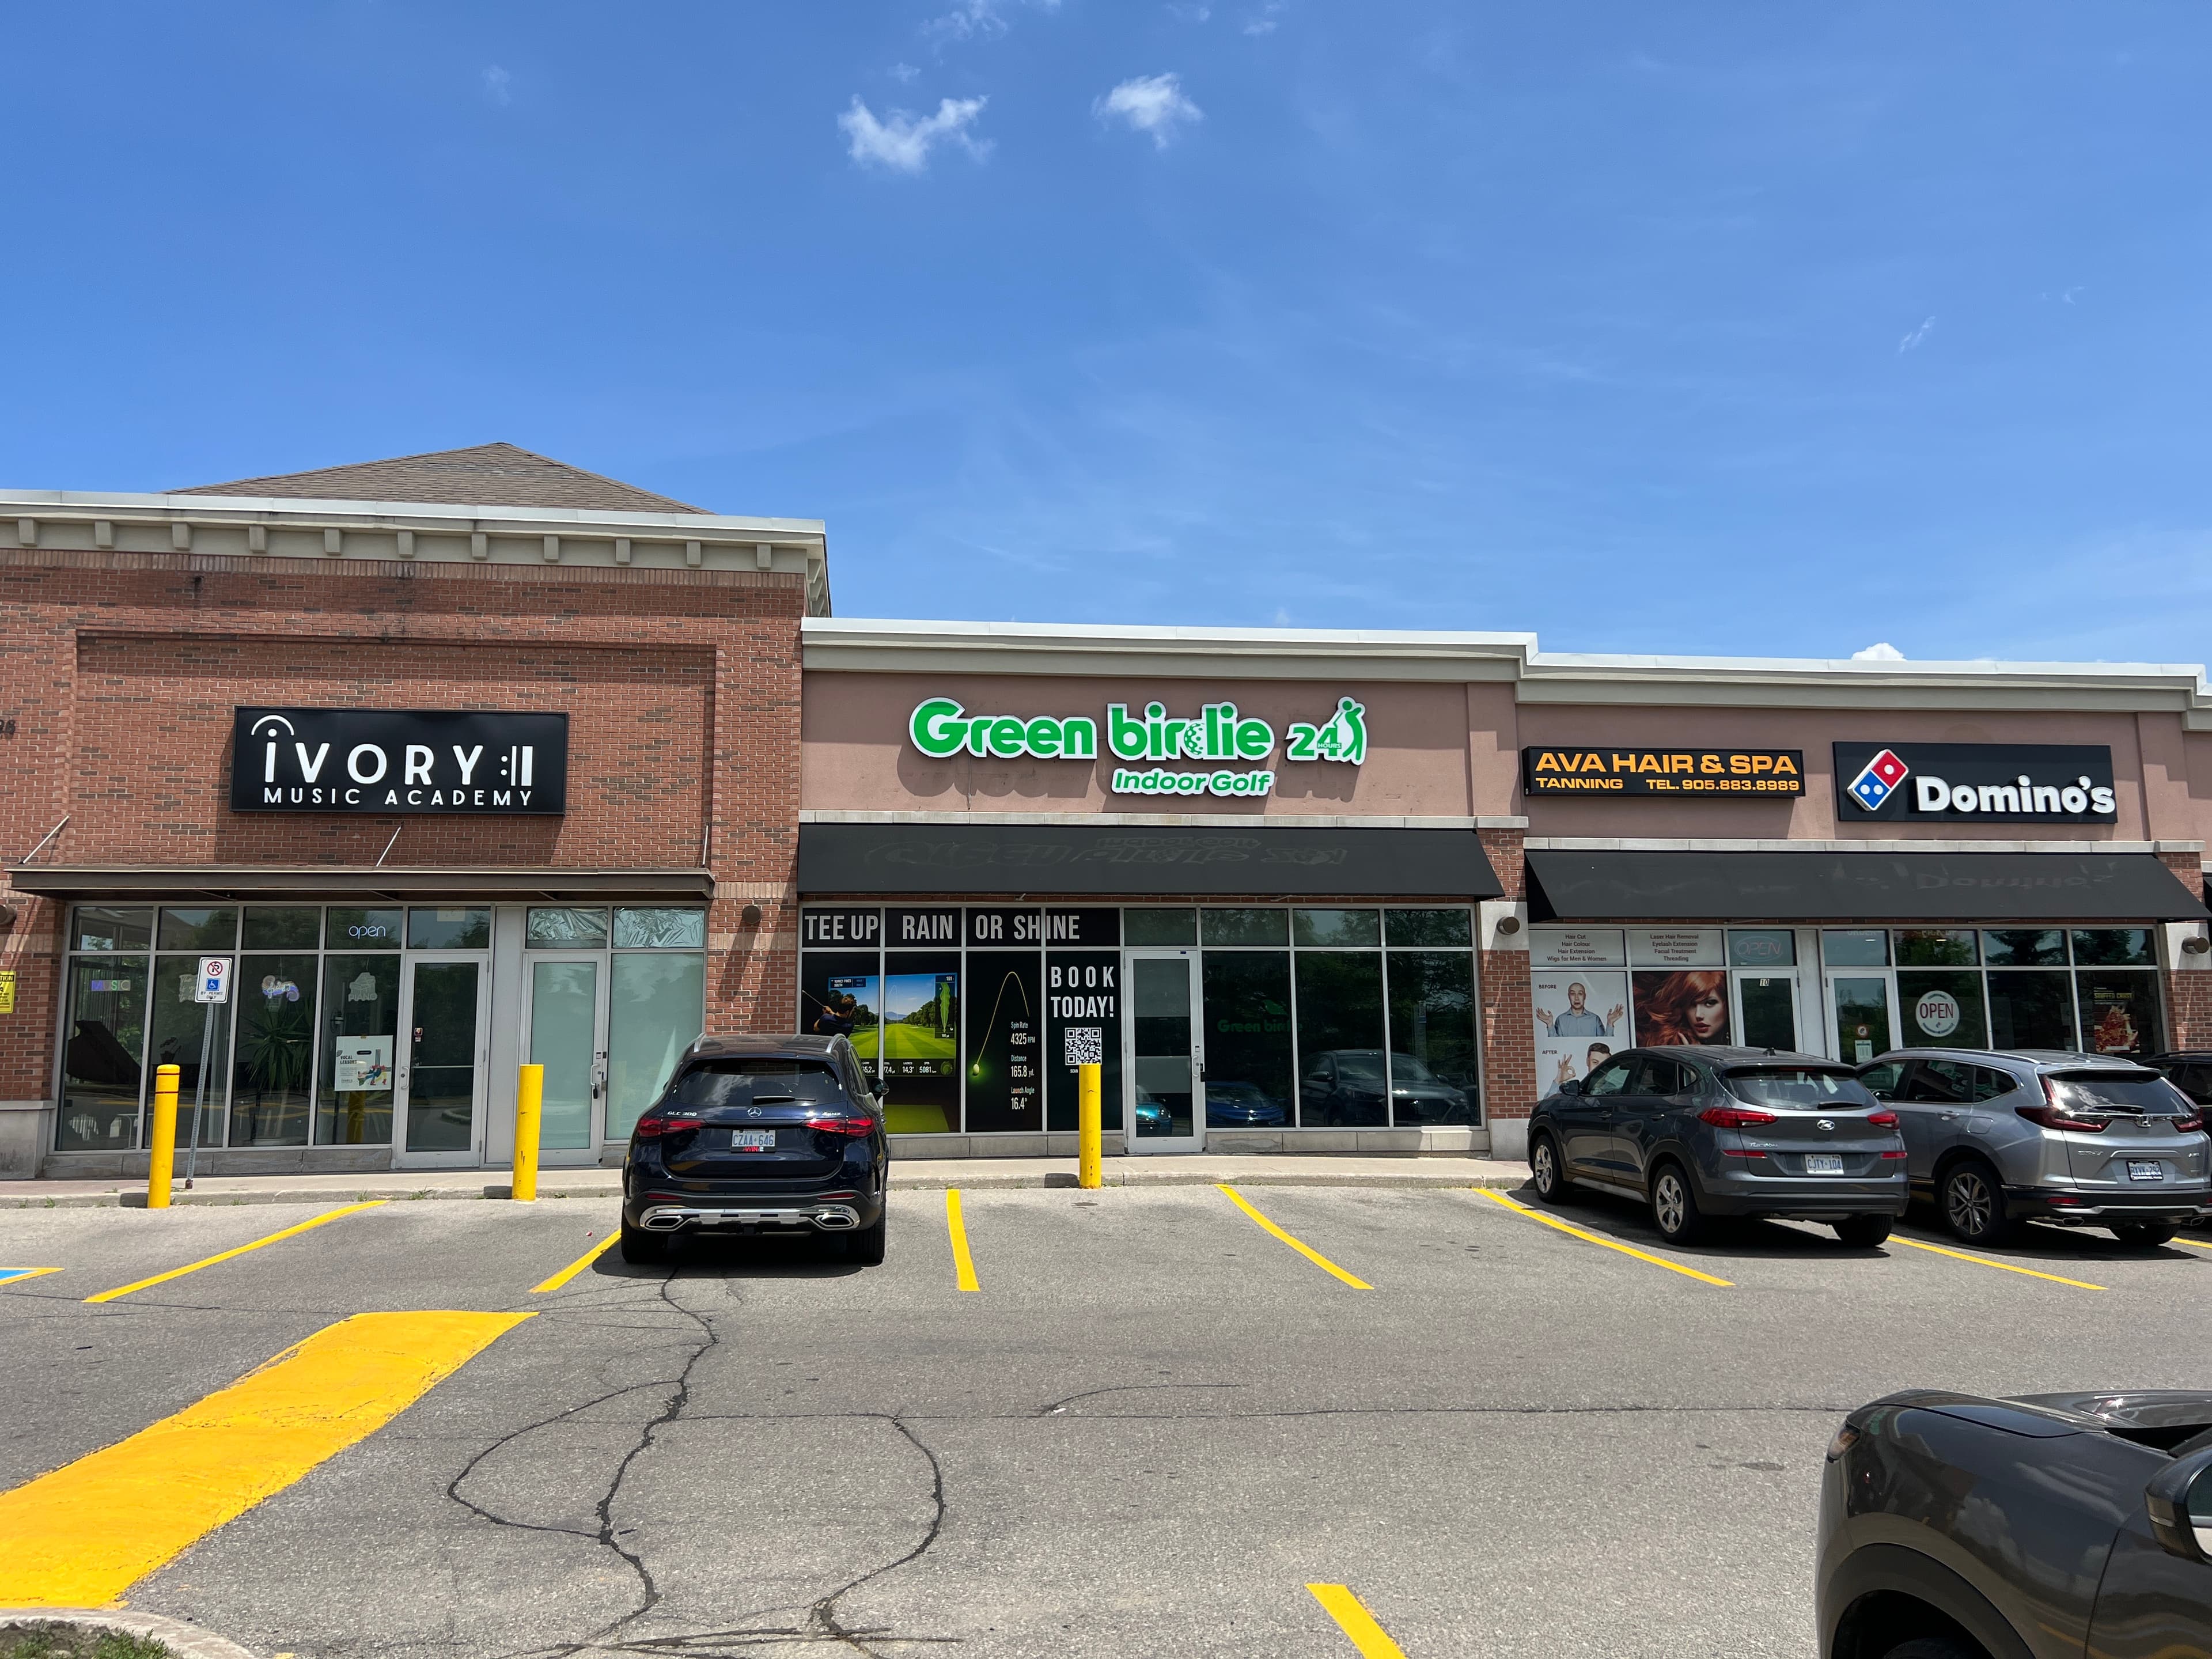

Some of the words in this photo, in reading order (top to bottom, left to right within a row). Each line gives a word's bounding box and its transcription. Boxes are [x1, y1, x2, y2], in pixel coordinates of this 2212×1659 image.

[912, 700, 1094, 756] Green
[1109, 703, 1272, 757] birdie
[1291, 726, 1338, 756] 24
[1535, 752, 1607, 772] AVA
[1612, 753, 1695, 774] HAIR
[1700, 754, 1726, 774] &
[1730, 755, 1798, 775] SPA
[1115, 772, 1206, 790] Indoor
[1211, 774, 1270, 791] Golf
[1535, 778, 1624, 789] TANNING
[1645, 779, 1679, 790] TEL.
[1681, 779, 1800, 791] 905.883.8989
[263, 787, 361, 805] MUSIC
[384, 789, 532, 806] ACADEMY
[1915, 774, 2116, 813] Domino's
[349, 926, 386, 940] open
[804, 915, 844, 940] TEE
[850, 915, 878, 940] UP
[902, 914, 953, 940] RAIN
[975, 914, 1003, 940] OR
[1013, 914, 1080, 940] SHINE
[1737, 942, 1781, 955] OPEN
[1051, 965, 1115, 988] BOOK
[1050, 995, 1115, 1018] TODAY!
[1919, 1003, 1954, 1018] OPEN
[1011, 1021, 1019, 1030] Spin
[1010, 1033, 1027, 1045] 4325
[1011, 1066, 1027, 1077] 165.8
[1011, 1086, 1024, 1094] Launch
[1024, 1086, 1035, 1095] Angle
[733, 1134, 753, 1146] CZAA
[758, 1134, 774, 1146] 646
[1829, 1159, 1841, 1170] 104
